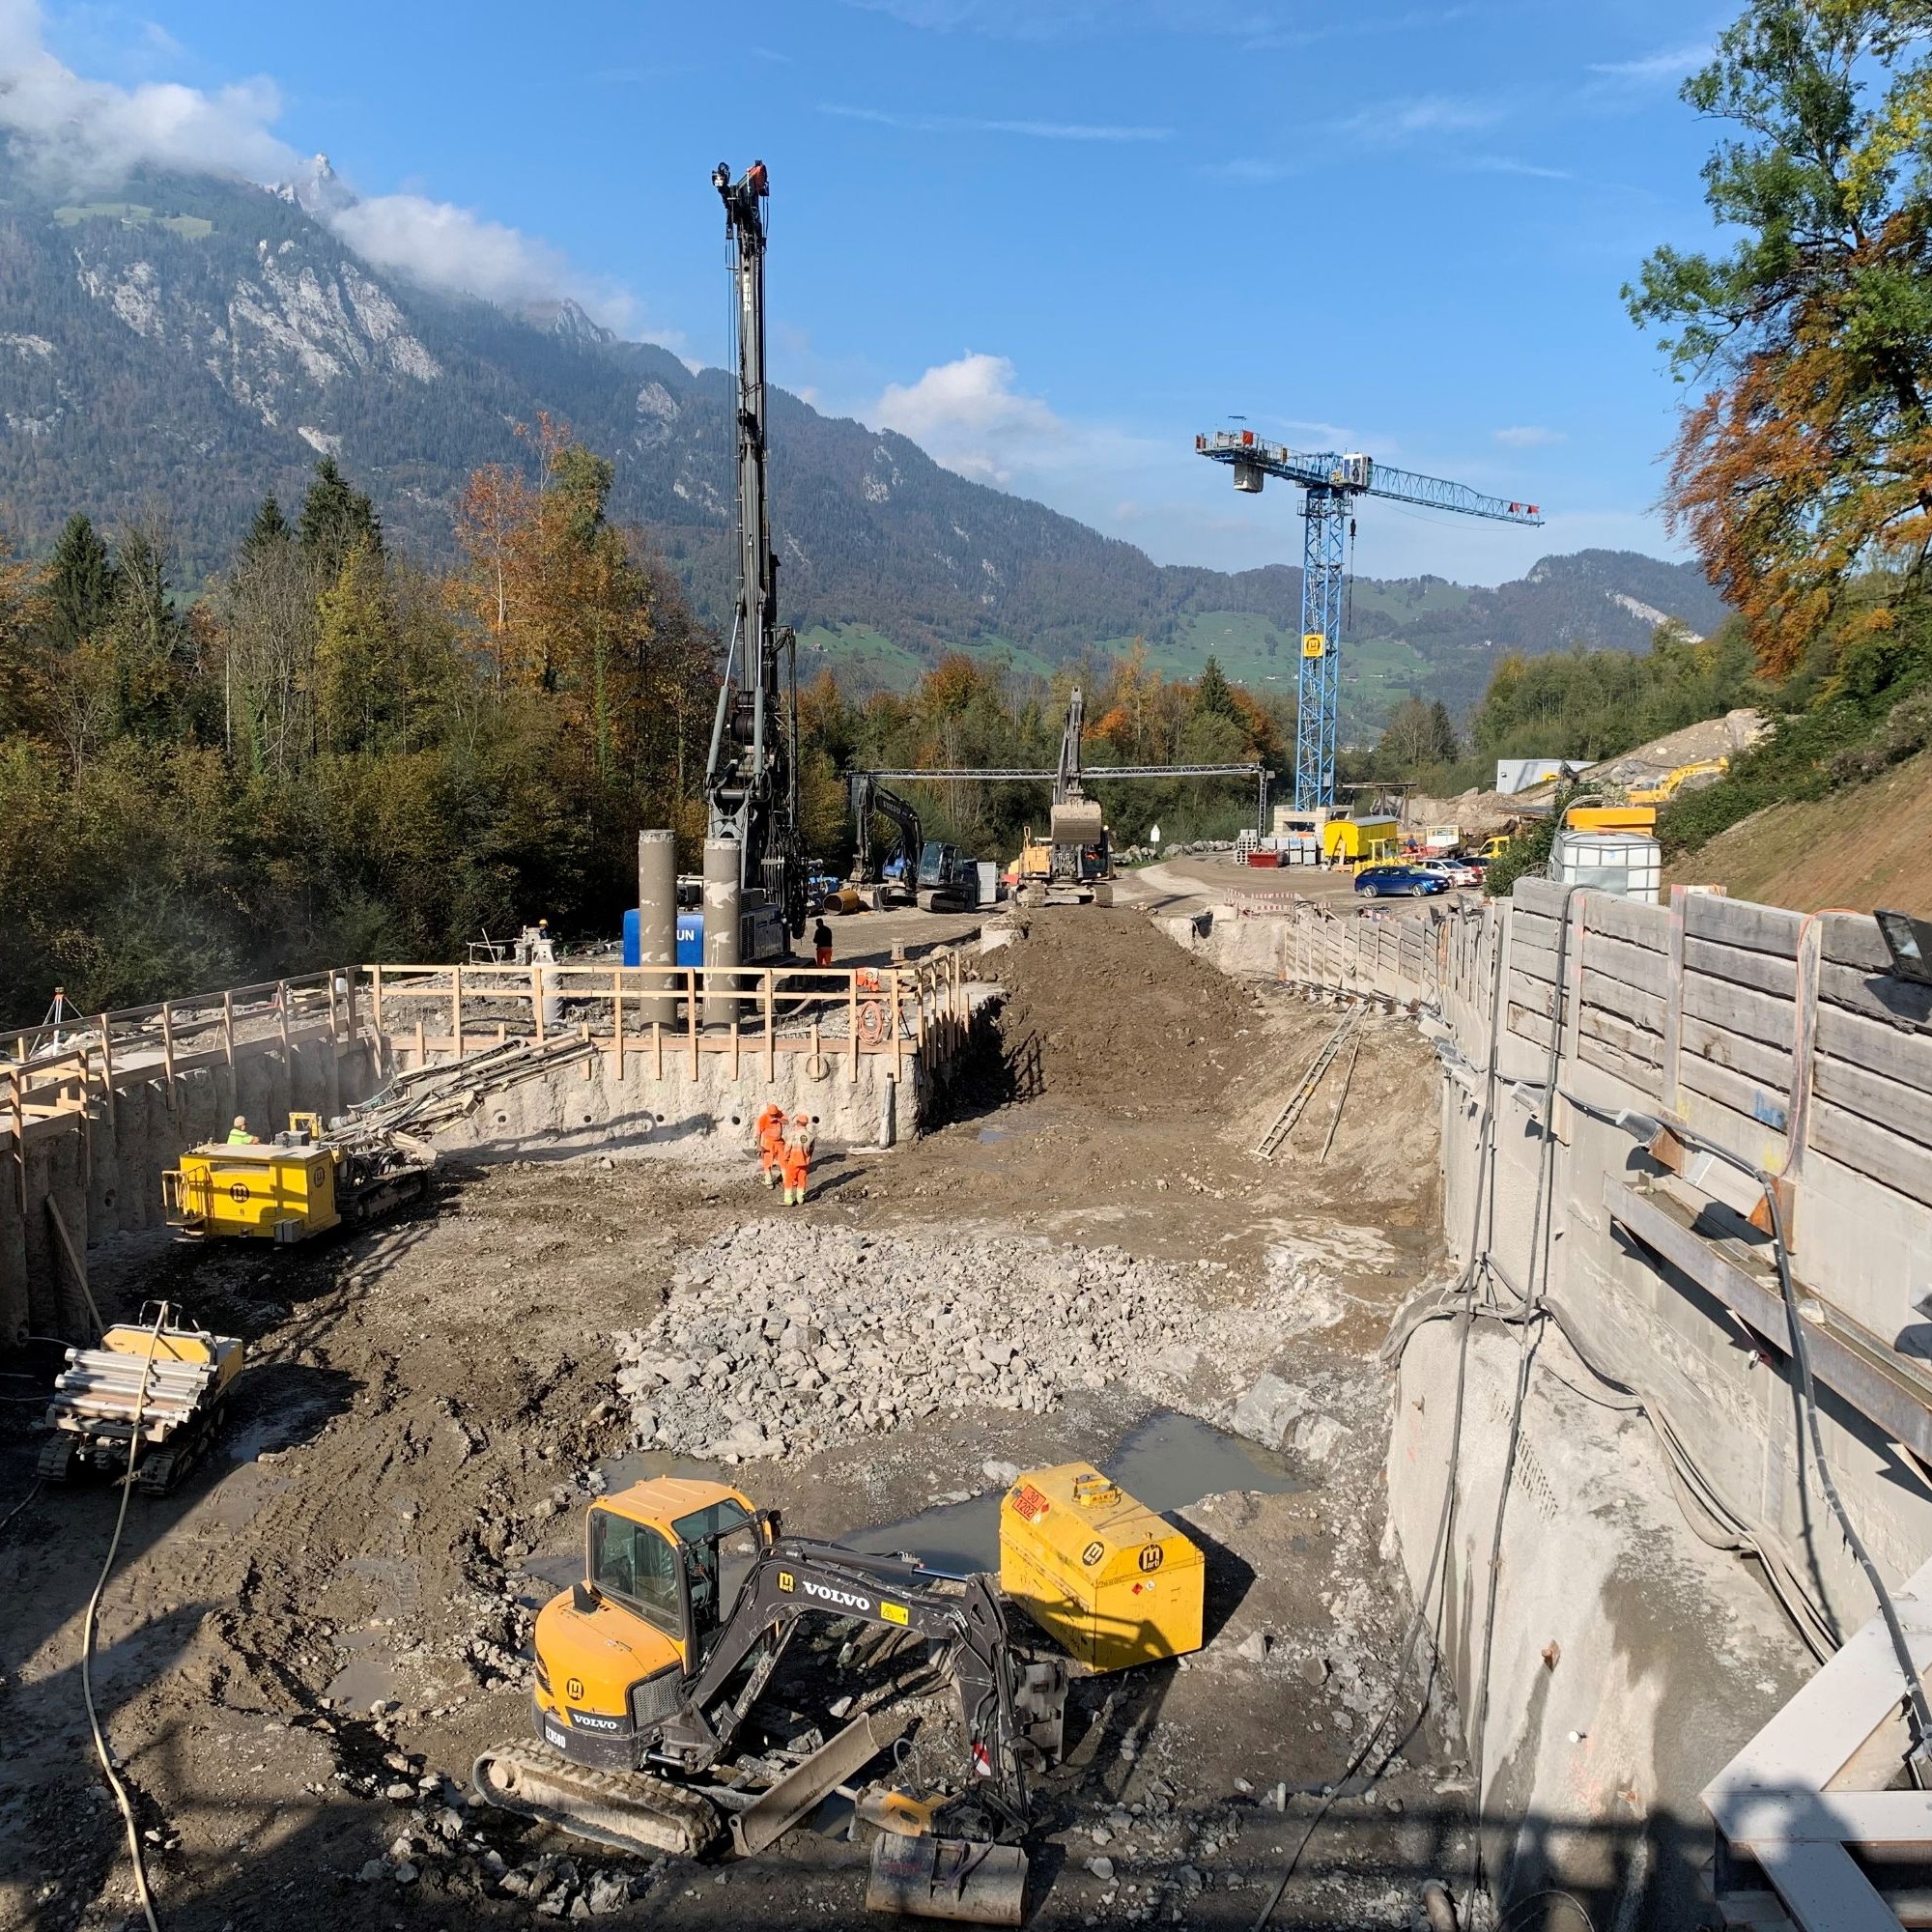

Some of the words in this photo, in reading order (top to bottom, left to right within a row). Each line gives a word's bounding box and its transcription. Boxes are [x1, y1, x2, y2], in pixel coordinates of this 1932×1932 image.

[1027, 1491, 1039, 1504] 30
[1016, 1499, 1035, 1519] 1202
[802, 1581, 870, 1611] VOLVO
[573, 1714, 617, 1730] VOLVO
